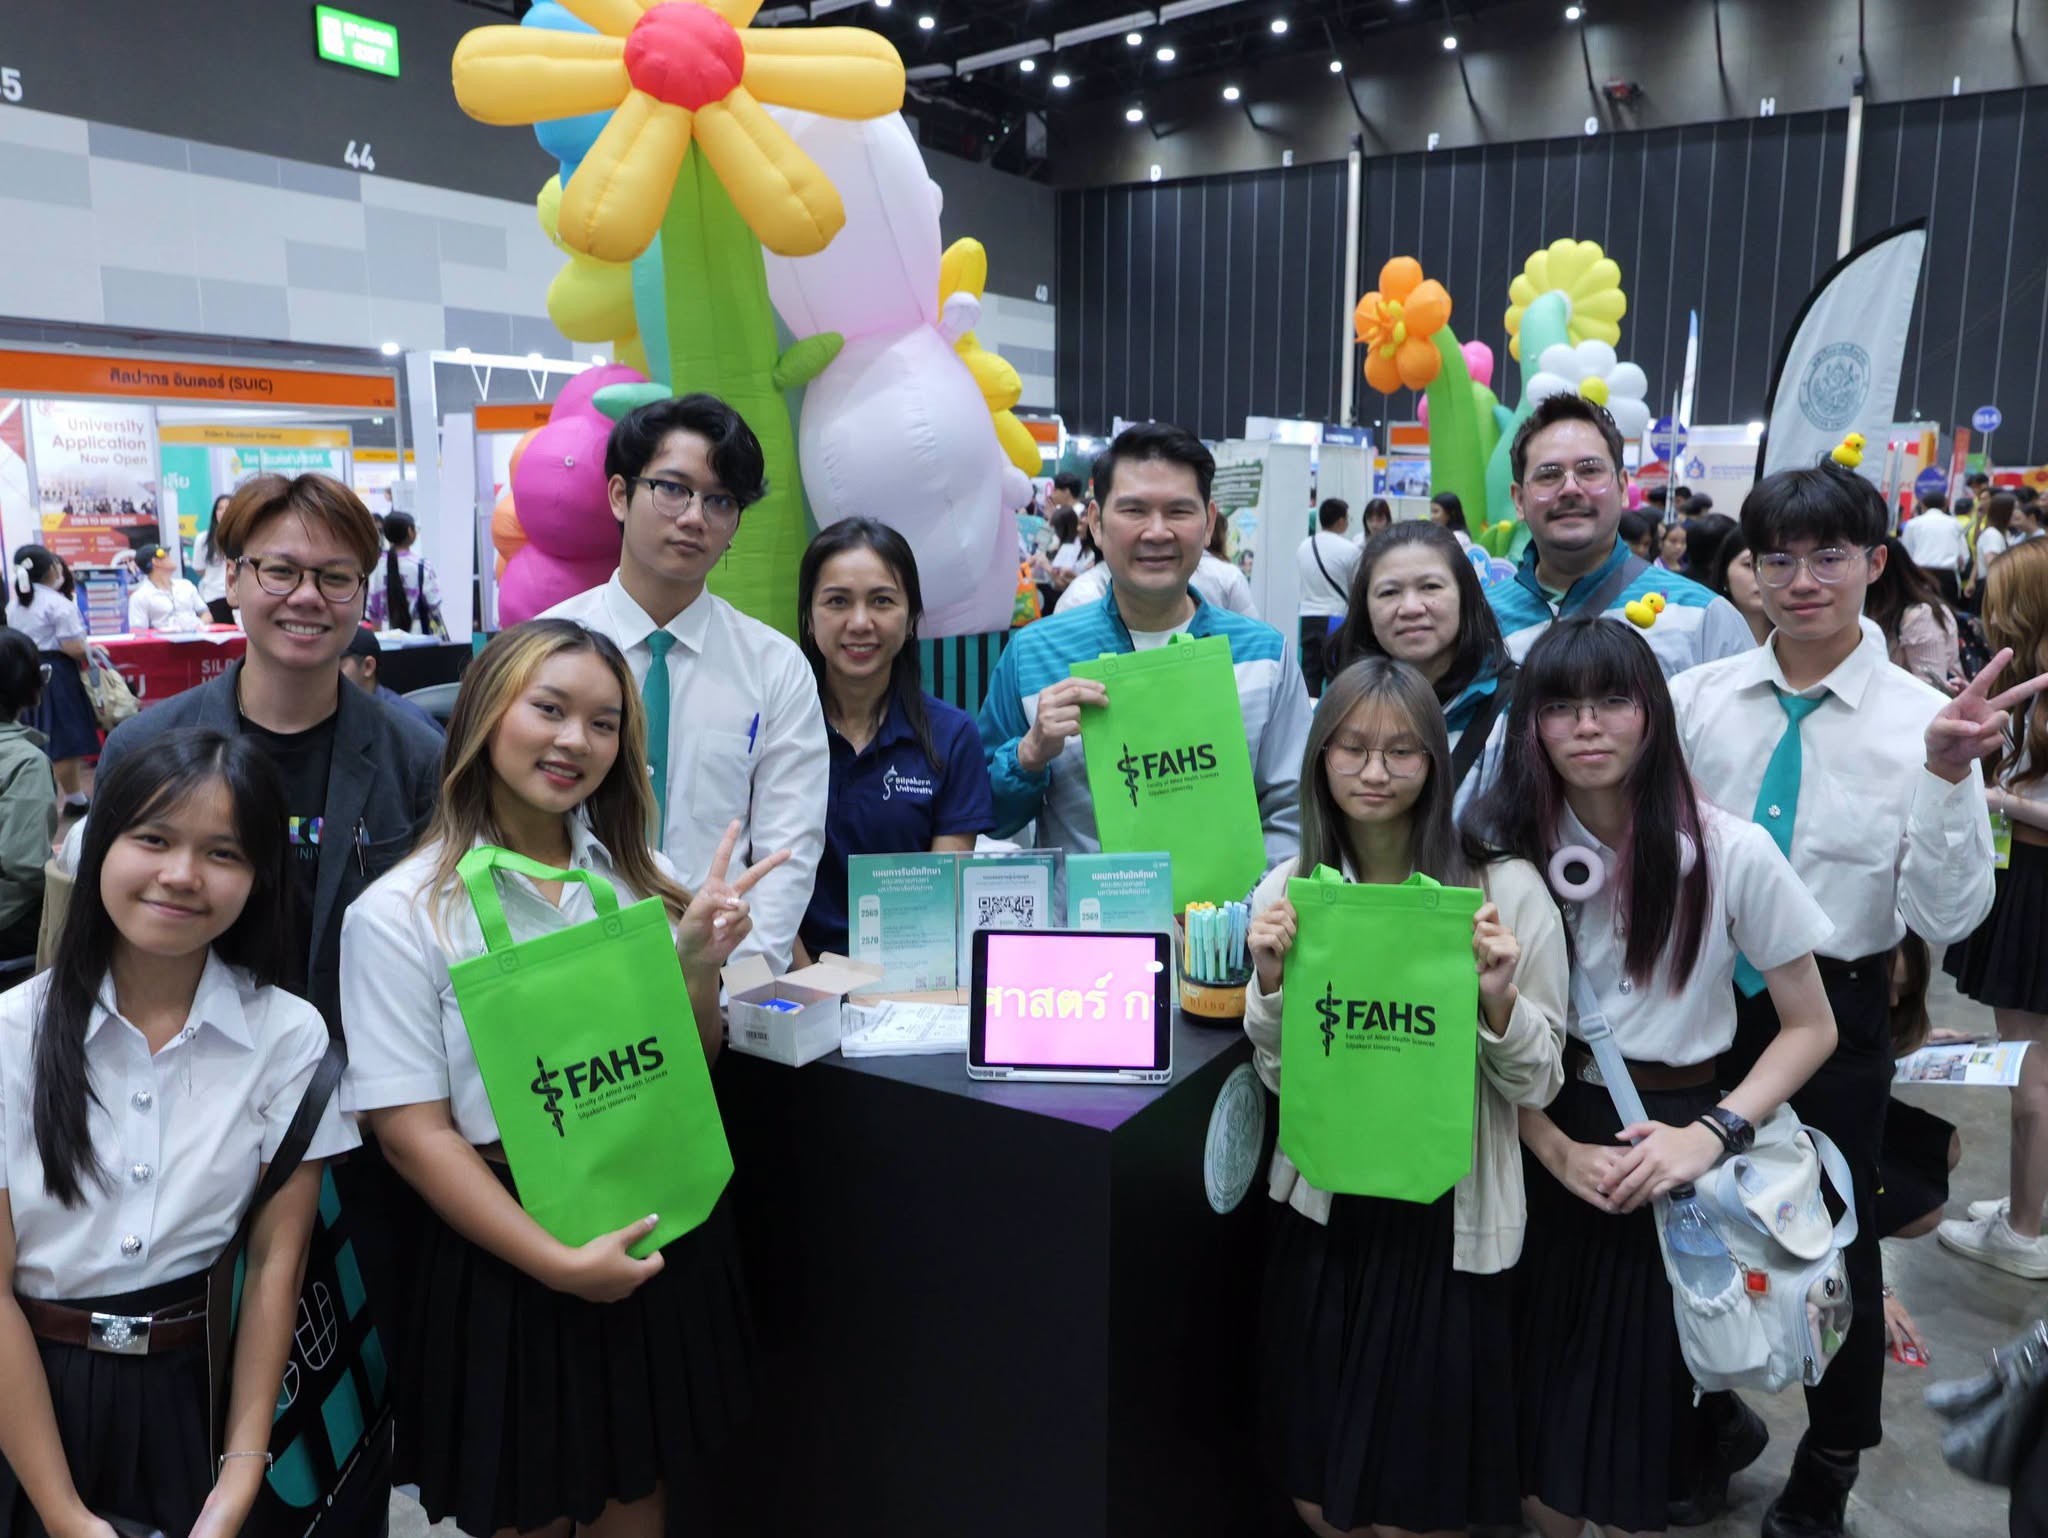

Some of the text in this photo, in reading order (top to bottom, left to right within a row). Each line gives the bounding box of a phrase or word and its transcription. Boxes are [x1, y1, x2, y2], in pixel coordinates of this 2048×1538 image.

[1760, 97, 1776, 117] H
[1427, 132, 1440, 151] F
[344, 139, 375, 171] 44
[1282, 149, 1293, 167] E
[1150, 164, 1162, 182] D
[109, 367, 169, 386] ศิลปากร
[229, 377, 273, 395] (SUIC)
[67, 418, 144, 435] University
[52, 434, 146, 452] Application
[80, 453, 148, 467] Now Open
[1142, 743, 1217, 780] FAHS
[895, 776, 931, 787] Silpakorn
[895, 784, 933, 796] University
[872, 867, 941, 878] แผนการรับนักศึกษา
[1092, 870, 1157, 880] แผนการรับนักศึกษา
[861, 909, 878, 918] 2569
[1081, 912, 1099, 921] 2569
[861, 936, 879, 945] 2570
[1124, 990, 1155, 1021] ก
[1347, 1000, 1436, 1036] FAHS
[1346, 1033, 1365, 1041] Faculty
[1392, 1034, 1411, 1043] Health
[1412, 1038, 1435, 1048] Sciences
[1346, 1042, 1401, 1053] Silpakorn University
[564, 1036, 664, 1099] FAHS
[575, 1097, 597, 1110] Faculty
[606, 1086, 622, 1098] Allied
[624, 1079, 644, 1091] Health
[645, 1069, 668, 1084] Sciences
[578, 1094, 637, 1119] Silpakorn University
